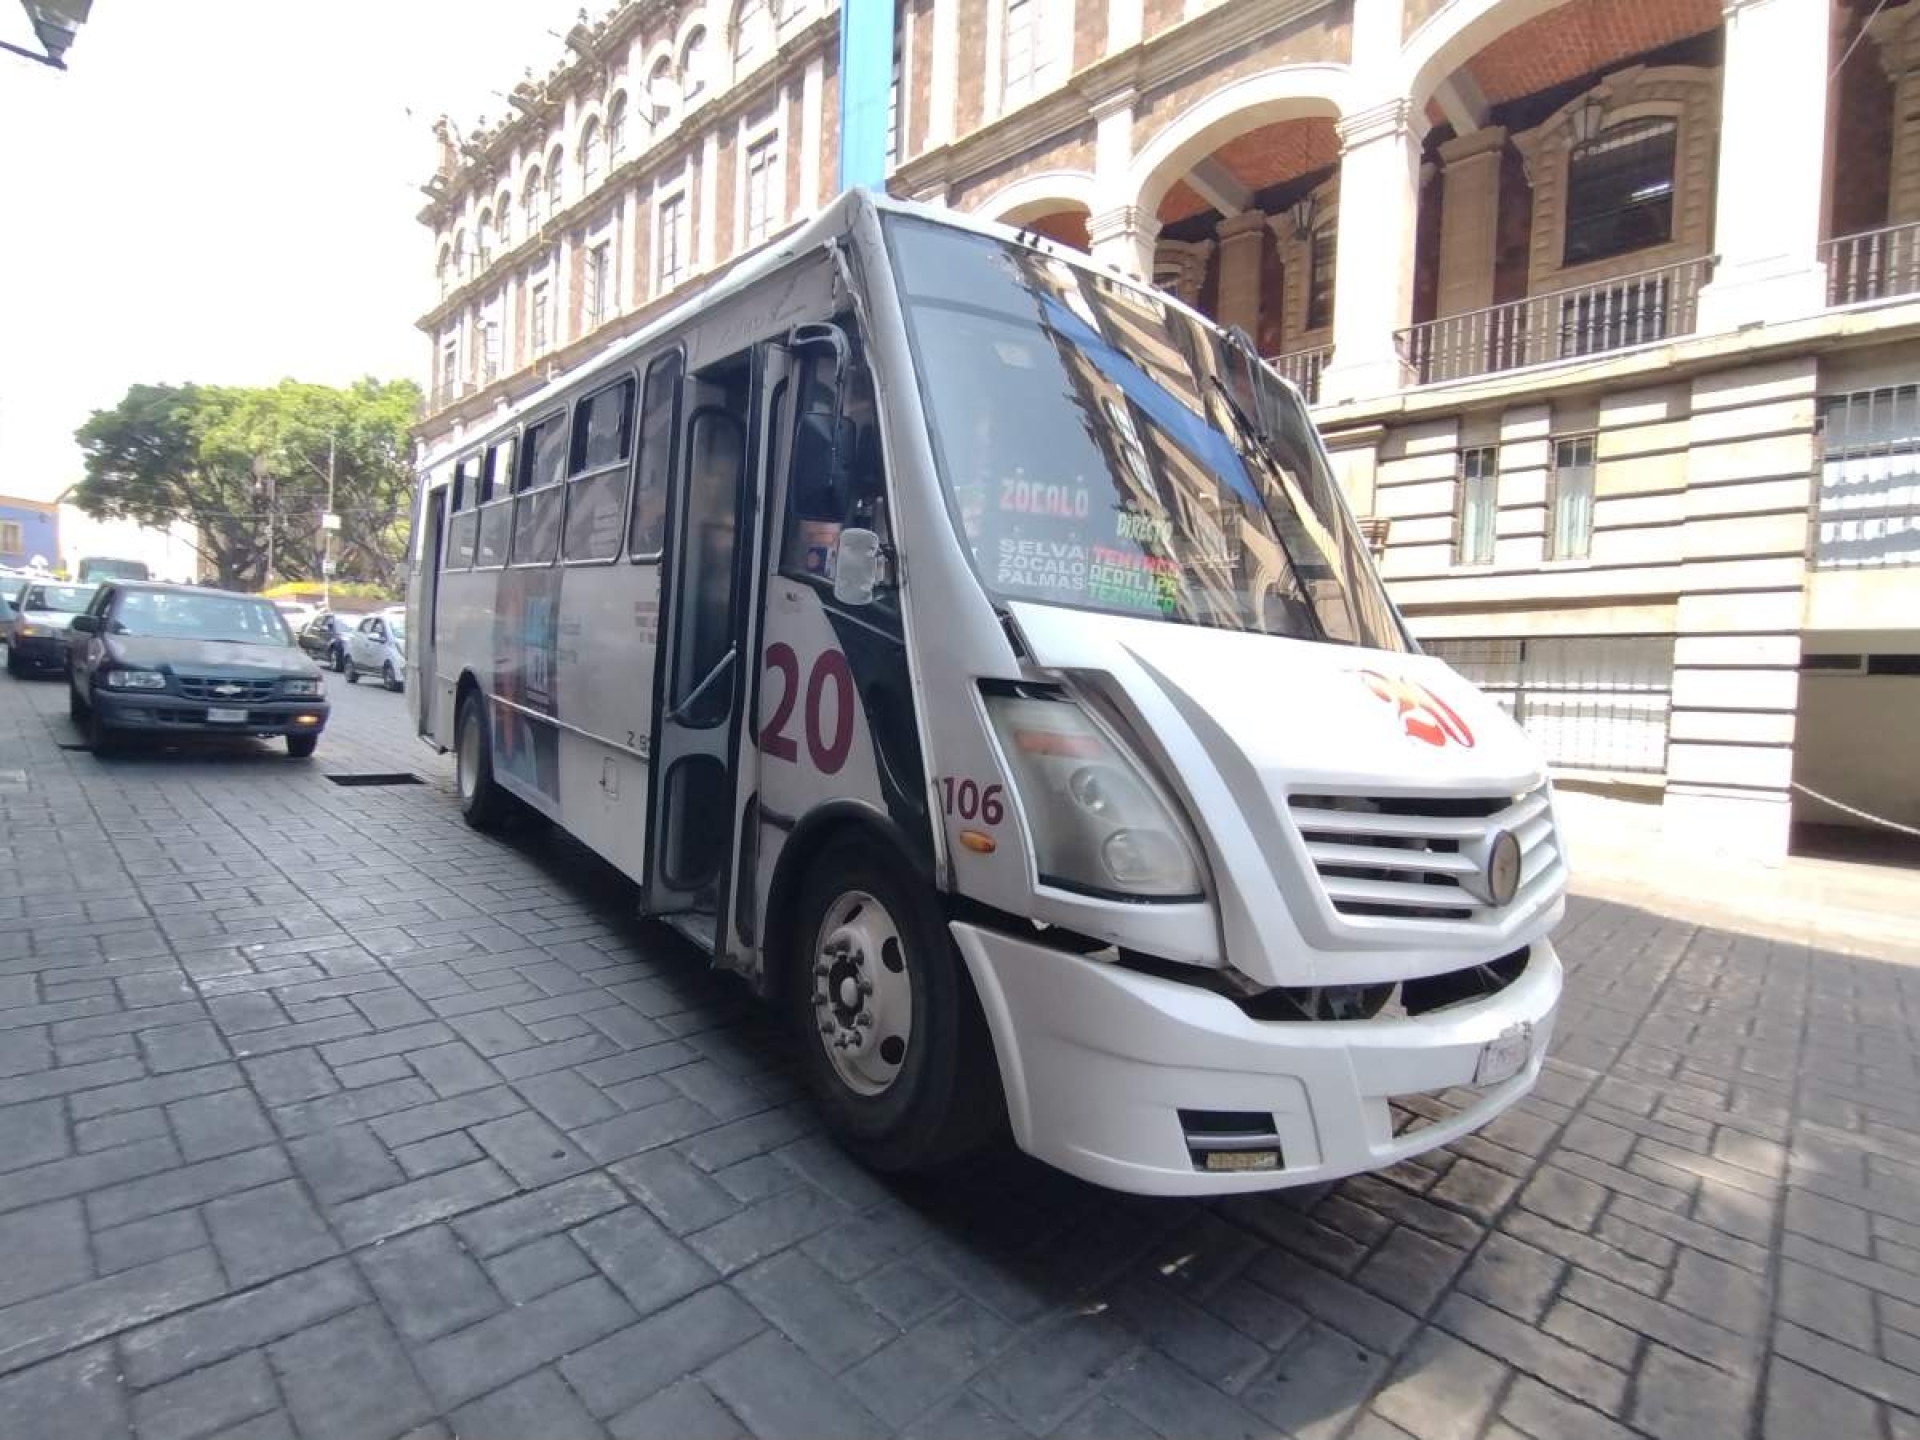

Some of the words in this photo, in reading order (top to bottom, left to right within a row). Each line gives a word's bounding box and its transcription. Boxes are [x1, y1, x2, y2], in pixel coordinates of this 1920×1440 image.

[998, 538, 1085, 561] SELVA
[998, 554, 1086, 576] ZOCALO
[998, 568, 1086, 590] PALMAS
[759, 641, 856, 775] 20
[943, 777, 1004, 825] 106
